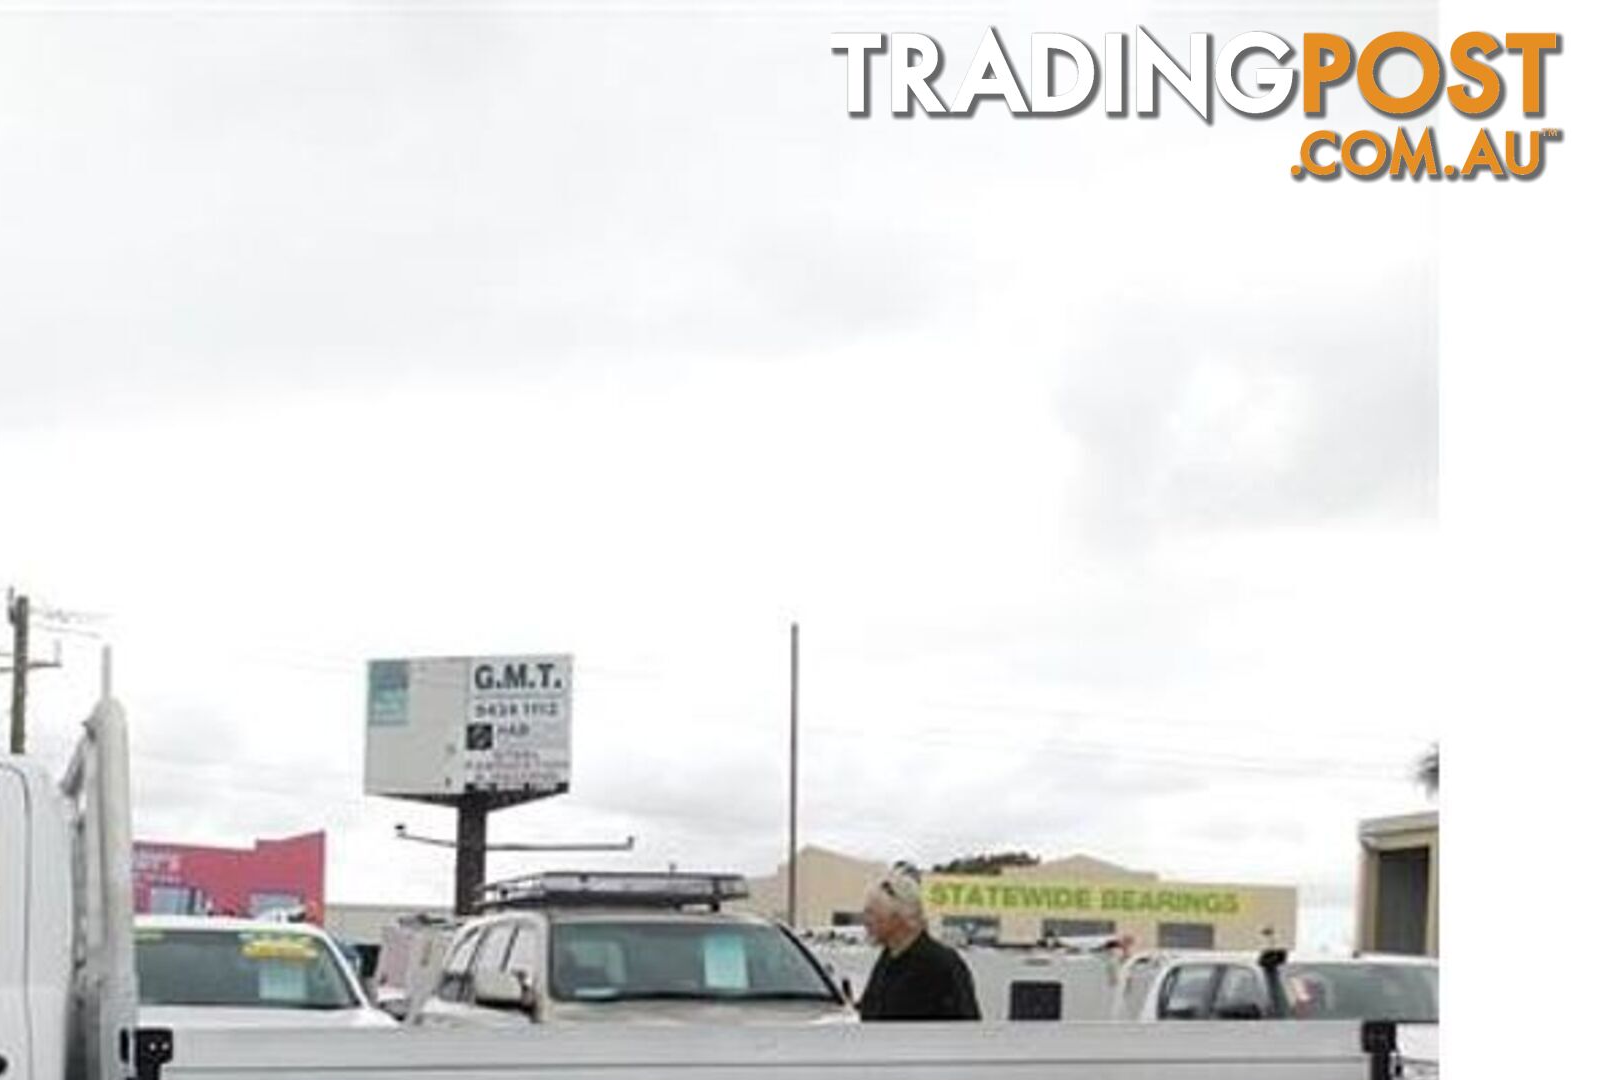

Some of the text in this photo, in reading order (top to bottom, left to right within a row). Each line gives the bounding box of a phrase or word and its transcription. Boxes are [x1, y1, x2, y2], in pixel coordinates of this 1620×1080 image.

[475, 664, 562, 690] G.M.T.
[929, 884, 1240, 914] STATEWIDE BEARINGS
